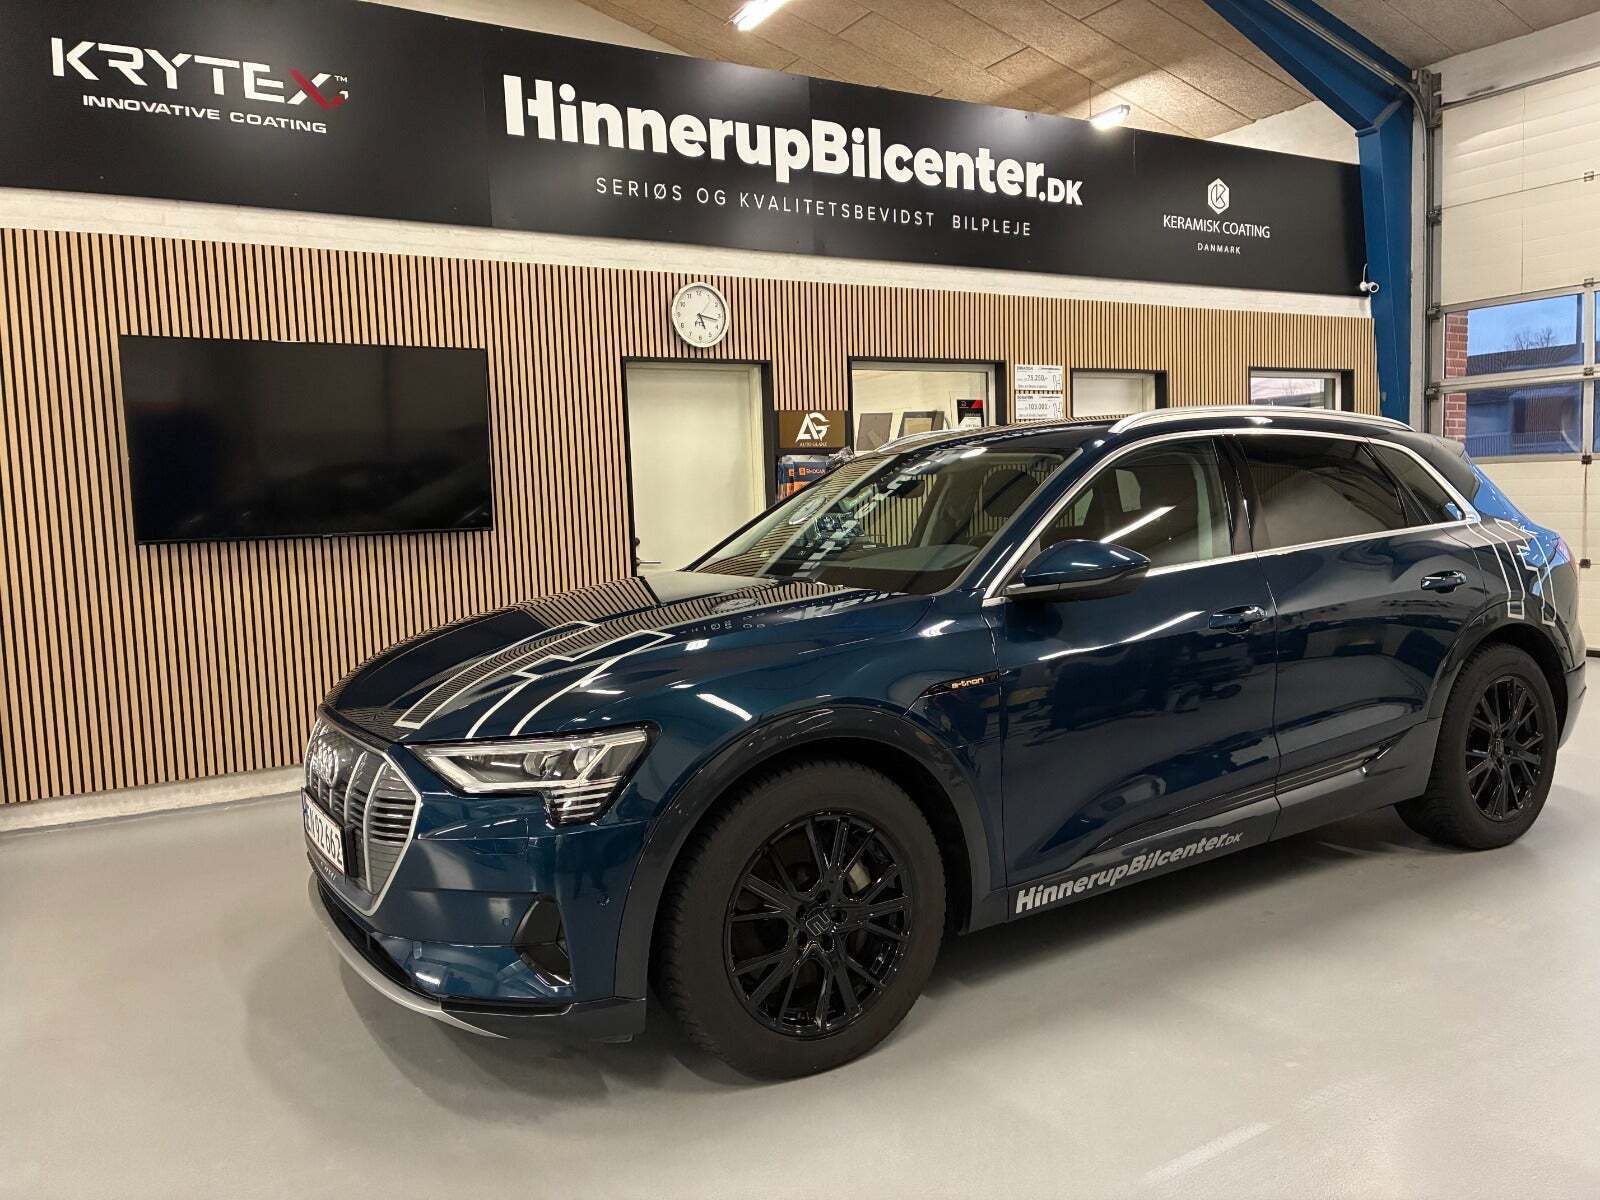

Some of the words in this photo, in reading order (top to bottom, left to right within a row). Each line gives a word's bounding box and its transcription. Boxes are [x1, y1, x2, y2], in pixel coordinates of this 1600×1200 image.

[51, 37, 348, 110] KRYTEX
[82, 93, 221, 121] INNOVATIVE
[229, 111, 328, 135] COATING
[503, 74, 1084, 208] HinnerupBilcenter.DK
[595, 177, 683, 202] SERIØS
[696, 186, 729, 207] OG
[739, 190, 936, 228] KVALITETSBEVIDST
[951, 214, 1032, 238] BILPLEJE
[1163, 214, 1220, 234] KERAMISK
[1222, 221, 1271, 239] COATING
[1197, 243, 1241, 255] DANMARK
[951, 676, 984, 690] e-tron
[1015, 832, 1243, 914] HinnerupBilcenter.DK
